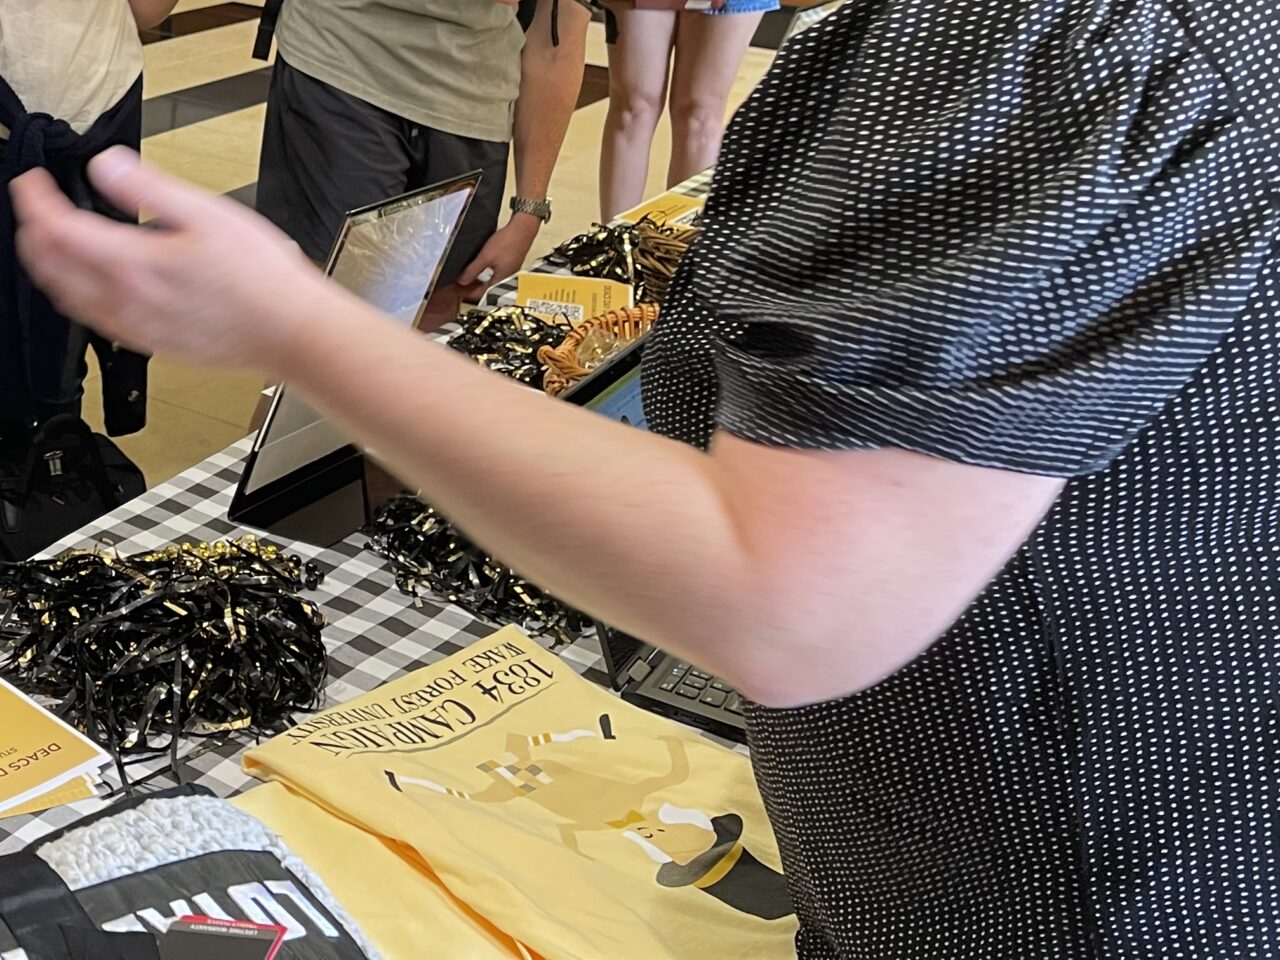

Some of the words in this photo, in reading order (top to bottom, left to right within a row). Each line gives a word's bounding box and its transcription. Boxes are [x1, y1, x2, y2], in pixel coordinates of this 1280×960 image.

[461, 641, 526, 674] WAKE
[390, 669, 468, 714] FOREST
[471, 658, 555, 704] 1834
[286, 702, 394, 746] UNIVERSITY
[308, 698, 477, 757] CAMPAIGN
[8, 742, 63, 772] DEACS
